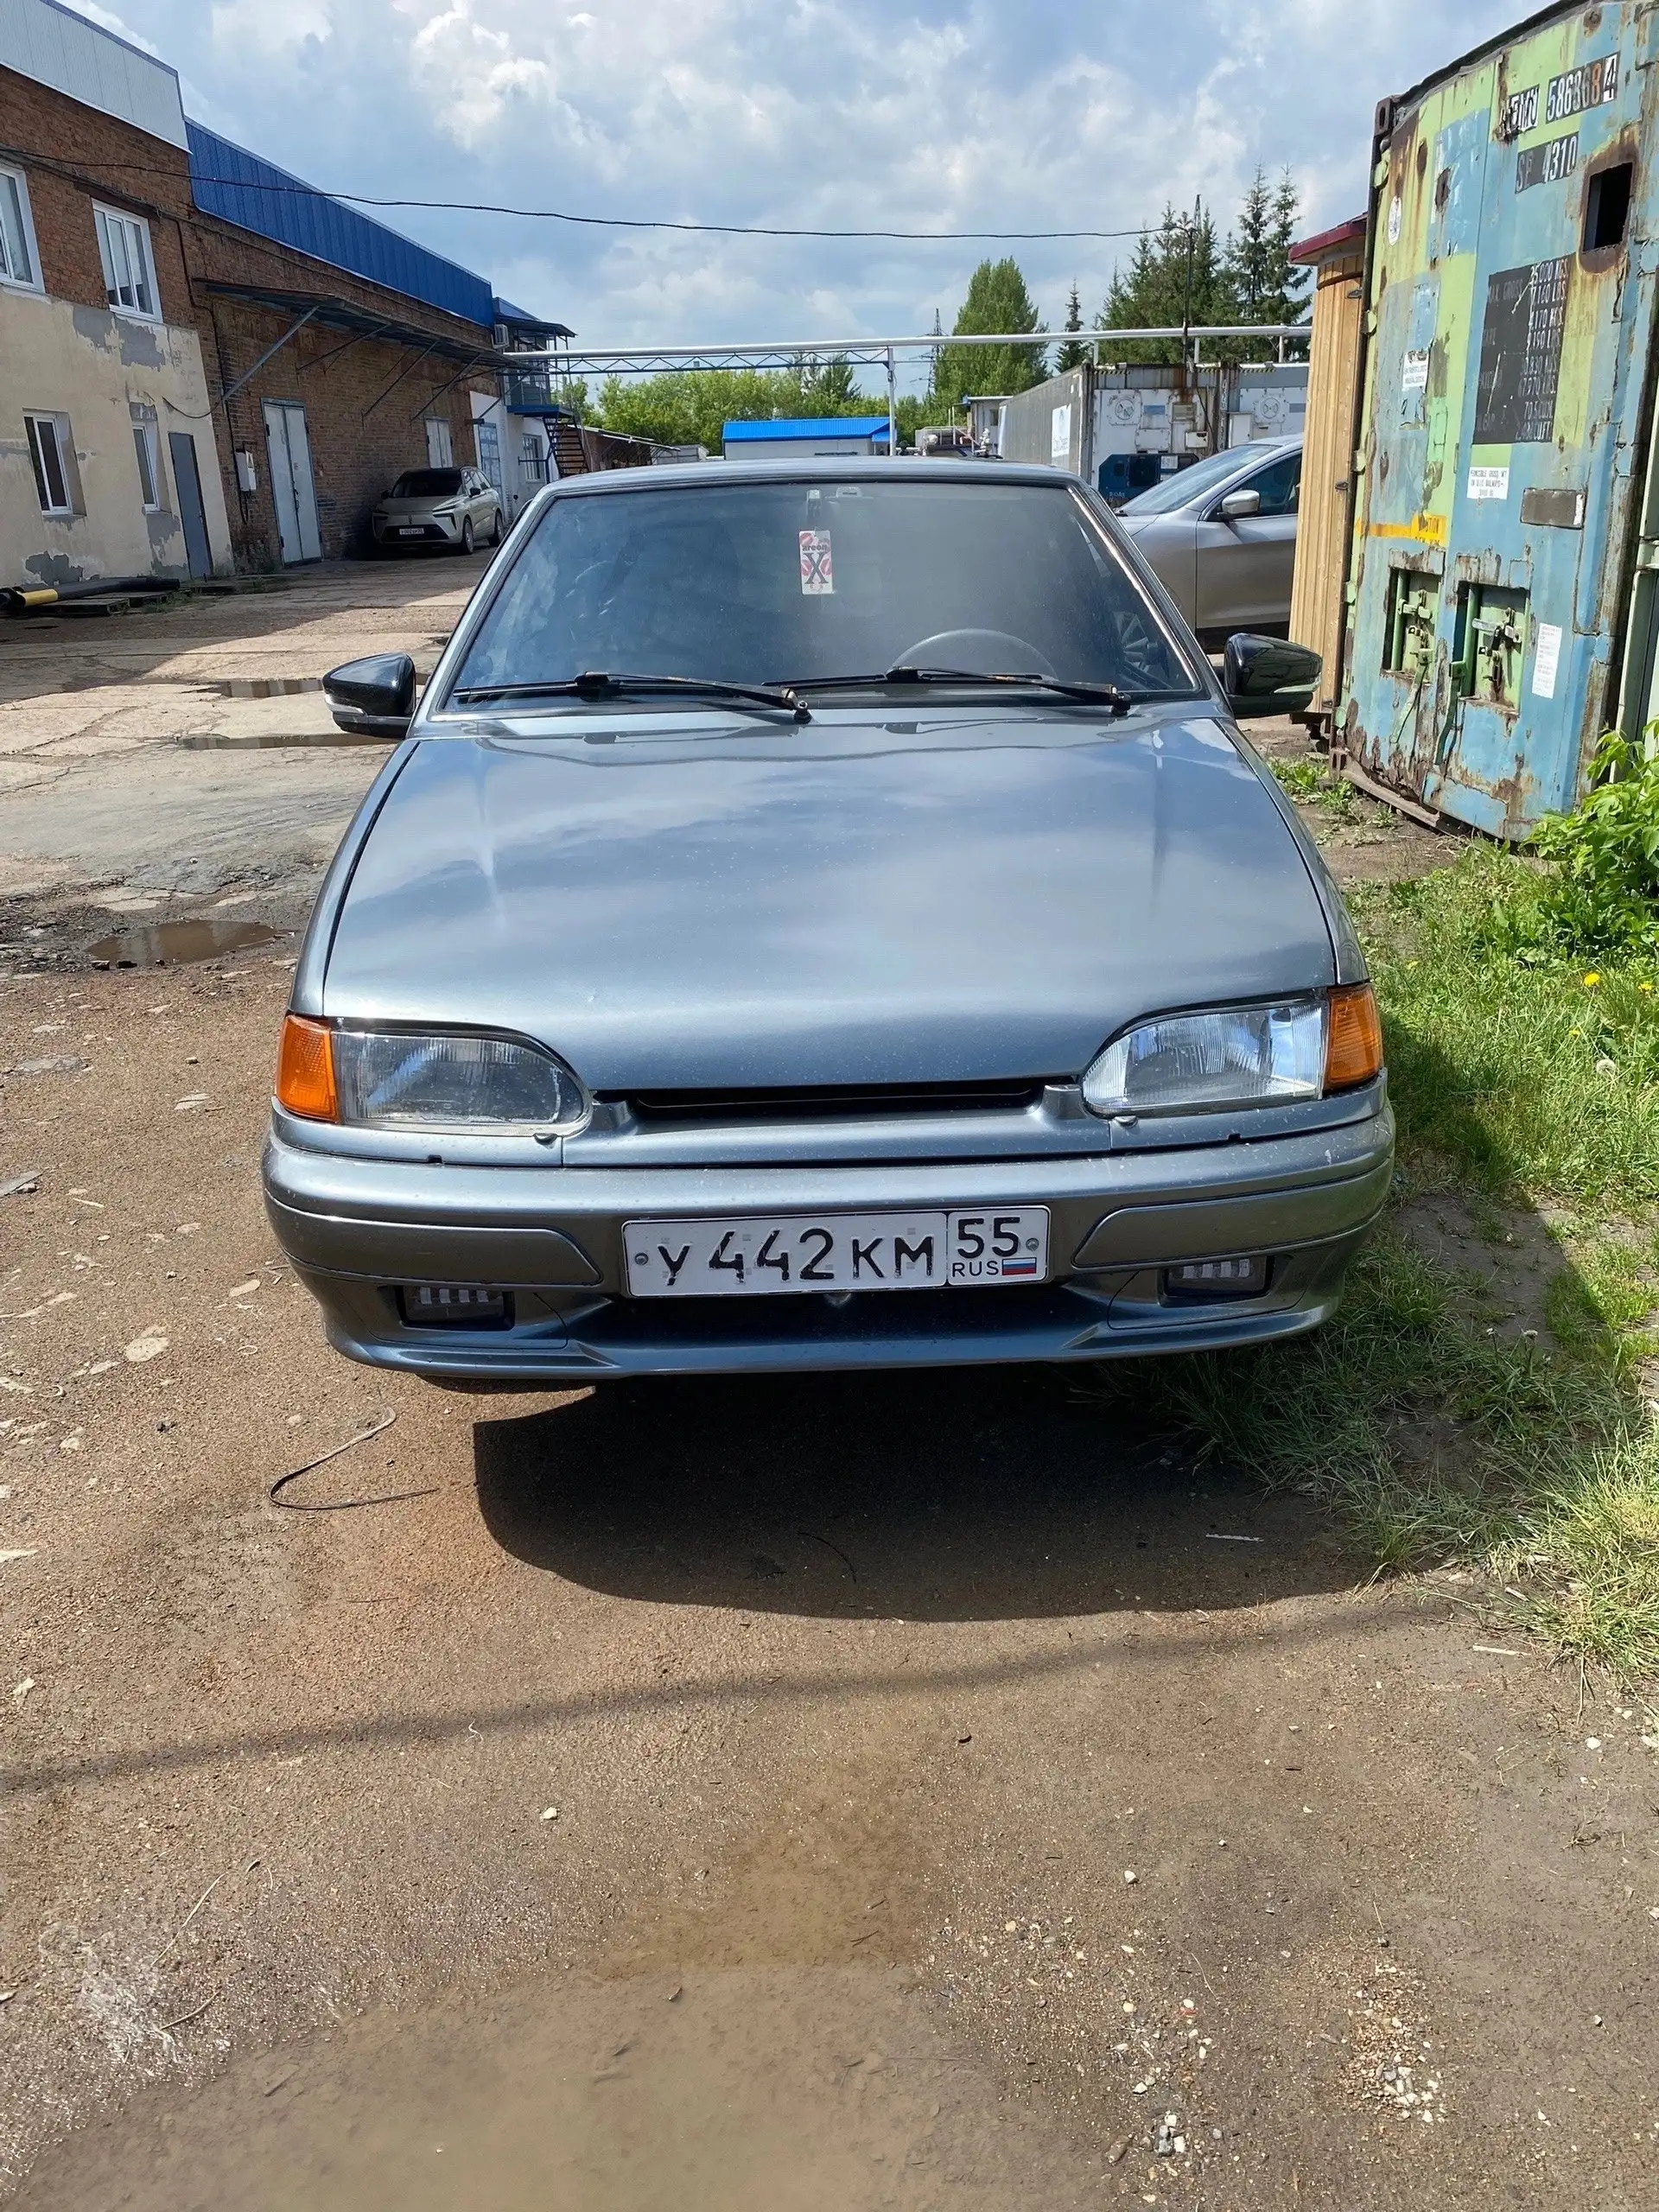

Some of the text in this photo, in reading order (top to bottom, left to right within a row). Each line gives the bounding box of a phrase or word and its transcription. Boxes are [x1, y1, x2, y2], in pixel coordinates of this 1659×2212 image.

[1542, 136, 1577, 182] 4310
[804, 553, 830, 584] X
[957, 1216, 1021, 1260] 55
[951, 1260, 1000, 1278] RUS
